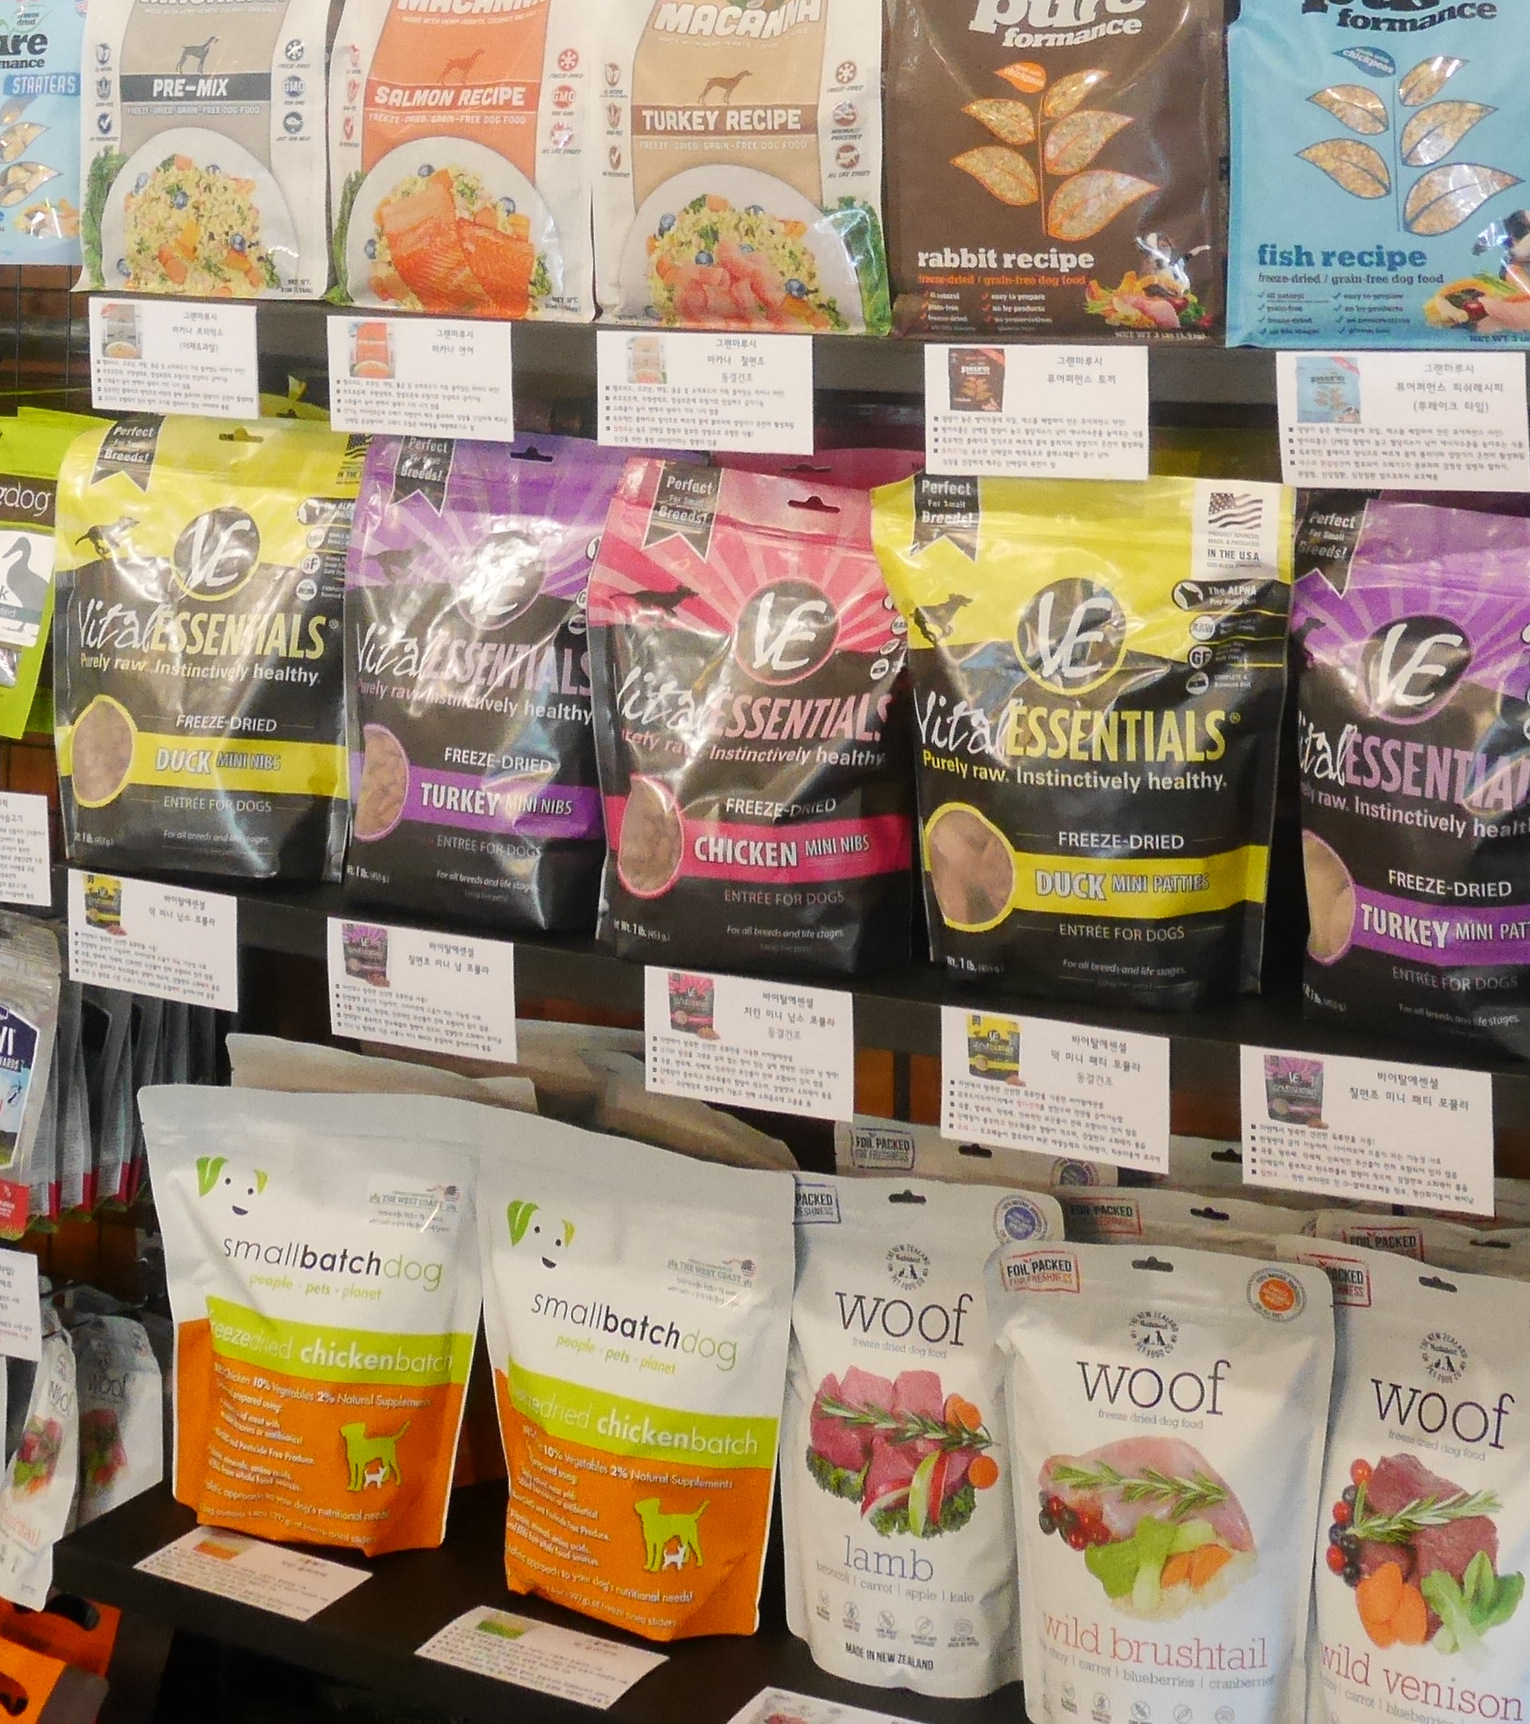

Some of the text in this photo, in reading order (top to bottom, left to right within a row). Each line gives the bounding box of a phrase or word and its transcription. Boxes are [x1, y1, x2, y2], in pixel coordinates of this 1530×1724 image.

[1336, 3, 1497, 32] formance
[1001, 18, 1142, 48] formance
[12, 75, 77, 94] STARTERS
[153, 79, 229, 97] PRE-MIX
[374, 86, 525, 107] SALMON RECIPE
[641, 109, 801, 131] TURKEY RECIPE
[917, 248, 1095, 273] rabbit recipe
[1257, 244, 1428, 273] fish recipe
[921, 480, 972, 497] Perfect
[175, 714, 278, 733] FREEZE-DRIED
[155, 746, 248, 774] DUCK MINI
[922, 750, 1228, 793] Purely raw. Instinctively healthy.
[420, 783, 500, 817] TURKEY
[694, 835, 870, 868] CHICKEN MINI NIBS
[1058, 830, 1185, 851] FREEZE-DRIED
[1034, 869, 1210, 902] DUCK MINI PATTIES
[1388, 869, 1513, 898] FREEZE-DRIED
[1114, 925, 1142, 940] FOR
[1146, 925, 1186, 942] DOGS
[1361, 903, 1451, 949] TURKEY
[1454, 919, 1494, 941] MINI
[223, 1237, 443, 1291] smallbatchdog
[1007, 1257, 1073, 1276] FOIL PACKED
[531, 1292, 739, 1372] smallbatchdog
[835, 1292, 973, 1347] woof
[1077, 1360, 1231, 1417] woof
[1371, 1378, 1516, 1450] woof
[843, 1537, 934, 1582] lamb
[1044, 1611, 1269, 1670] wild brushtail
[1382, 1668, 1524, 1723] venison
